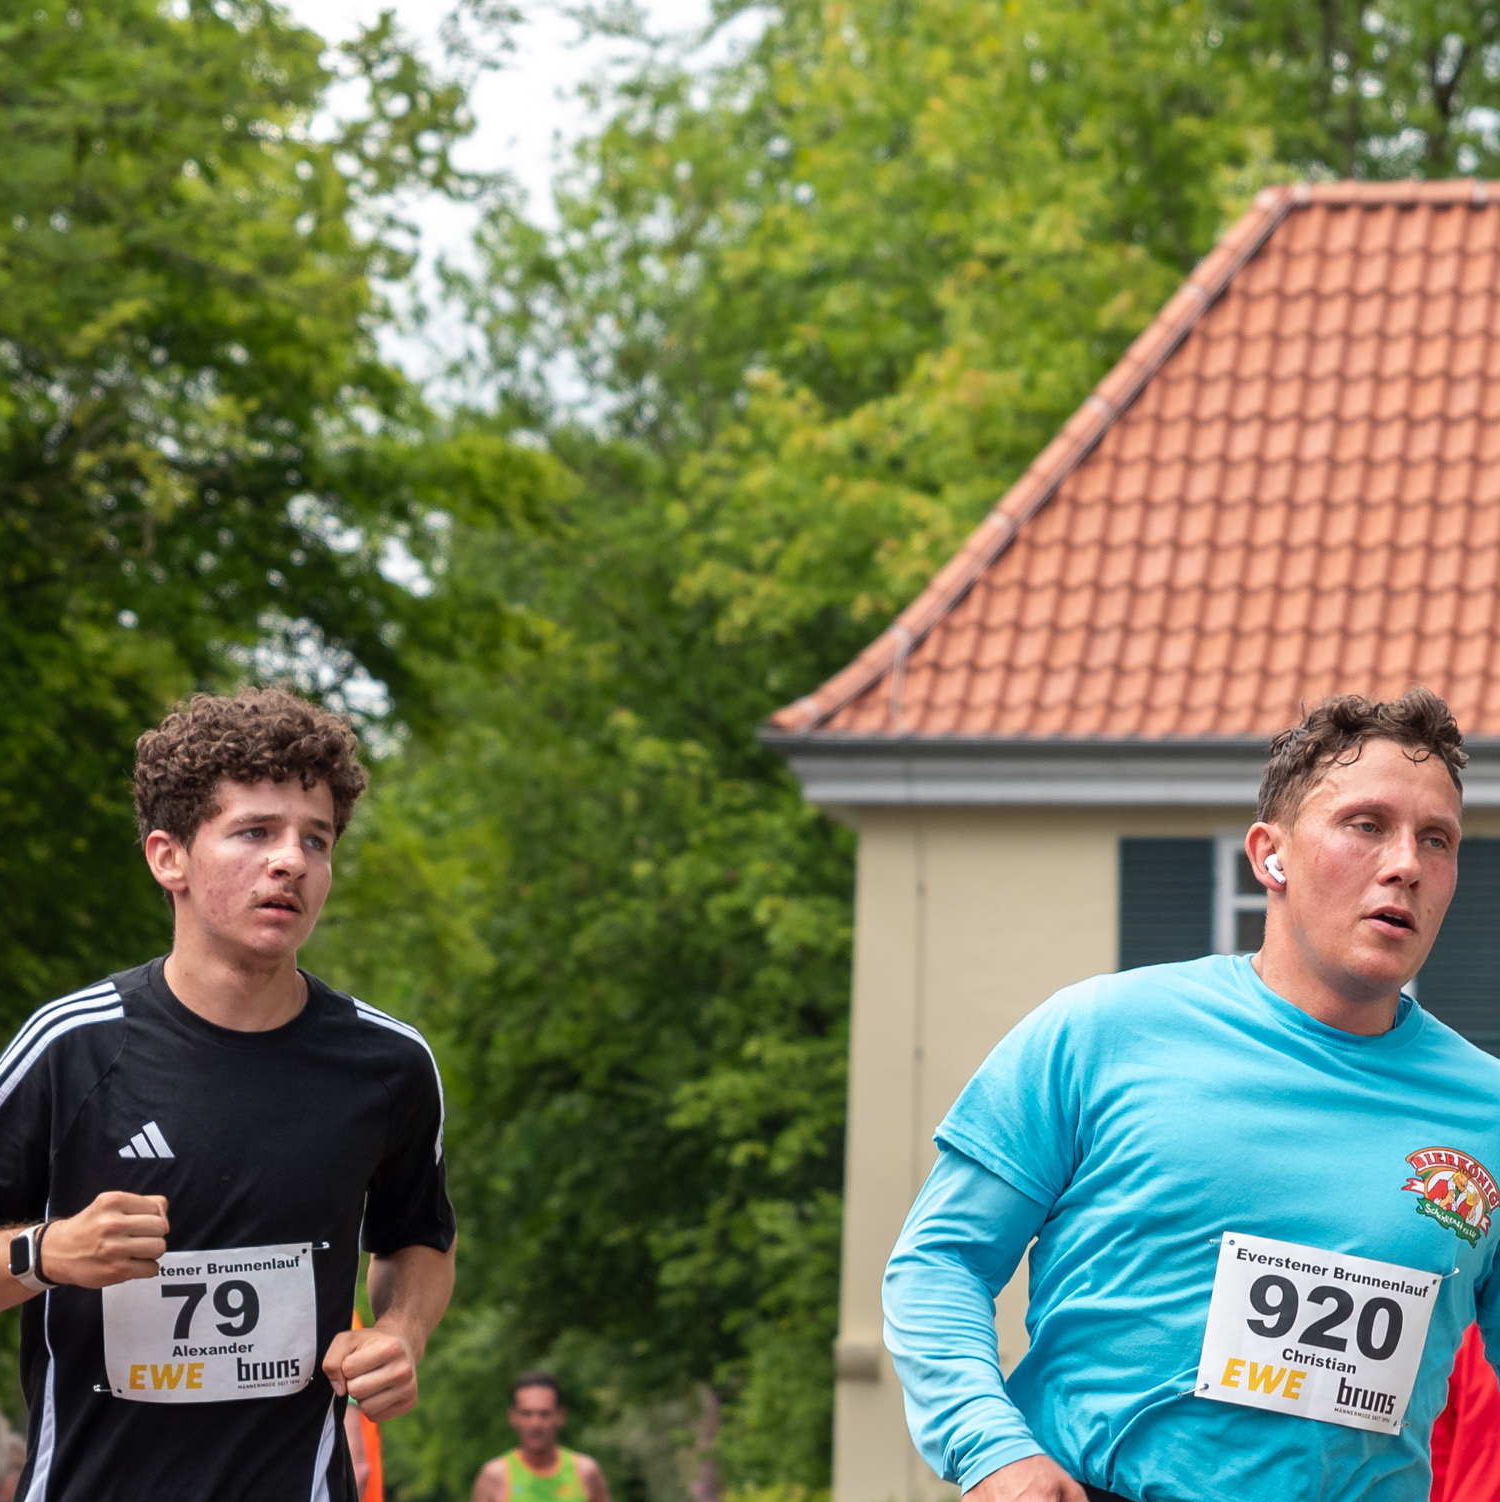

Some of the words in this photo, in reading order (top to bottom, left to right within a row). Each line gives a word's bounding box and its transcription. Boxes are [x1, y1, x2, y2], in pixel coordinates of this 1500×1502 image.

[156, 1265, 202, 1277] tener
[207, 1256, 300, 1275] Brunnenlauf
[1236, 1247, 1329, 1278] Everstener
[1333, 1266, 1429, 1299] Brunnenlauf
[161, 1279, 260, 1340] 79
[1246, 1274, 1404, 1361] 920
[172, 1342, 254, 1357] Alexander
[1282, 1348, 1357, 1374] Christian
[129, 1362, 204, 1390] EWE
[237, 1357, 300, 1382] bruns
[1220, 1357, 1307, 1400] EWE
[1336, 1376, 1397, 1415] bruns
